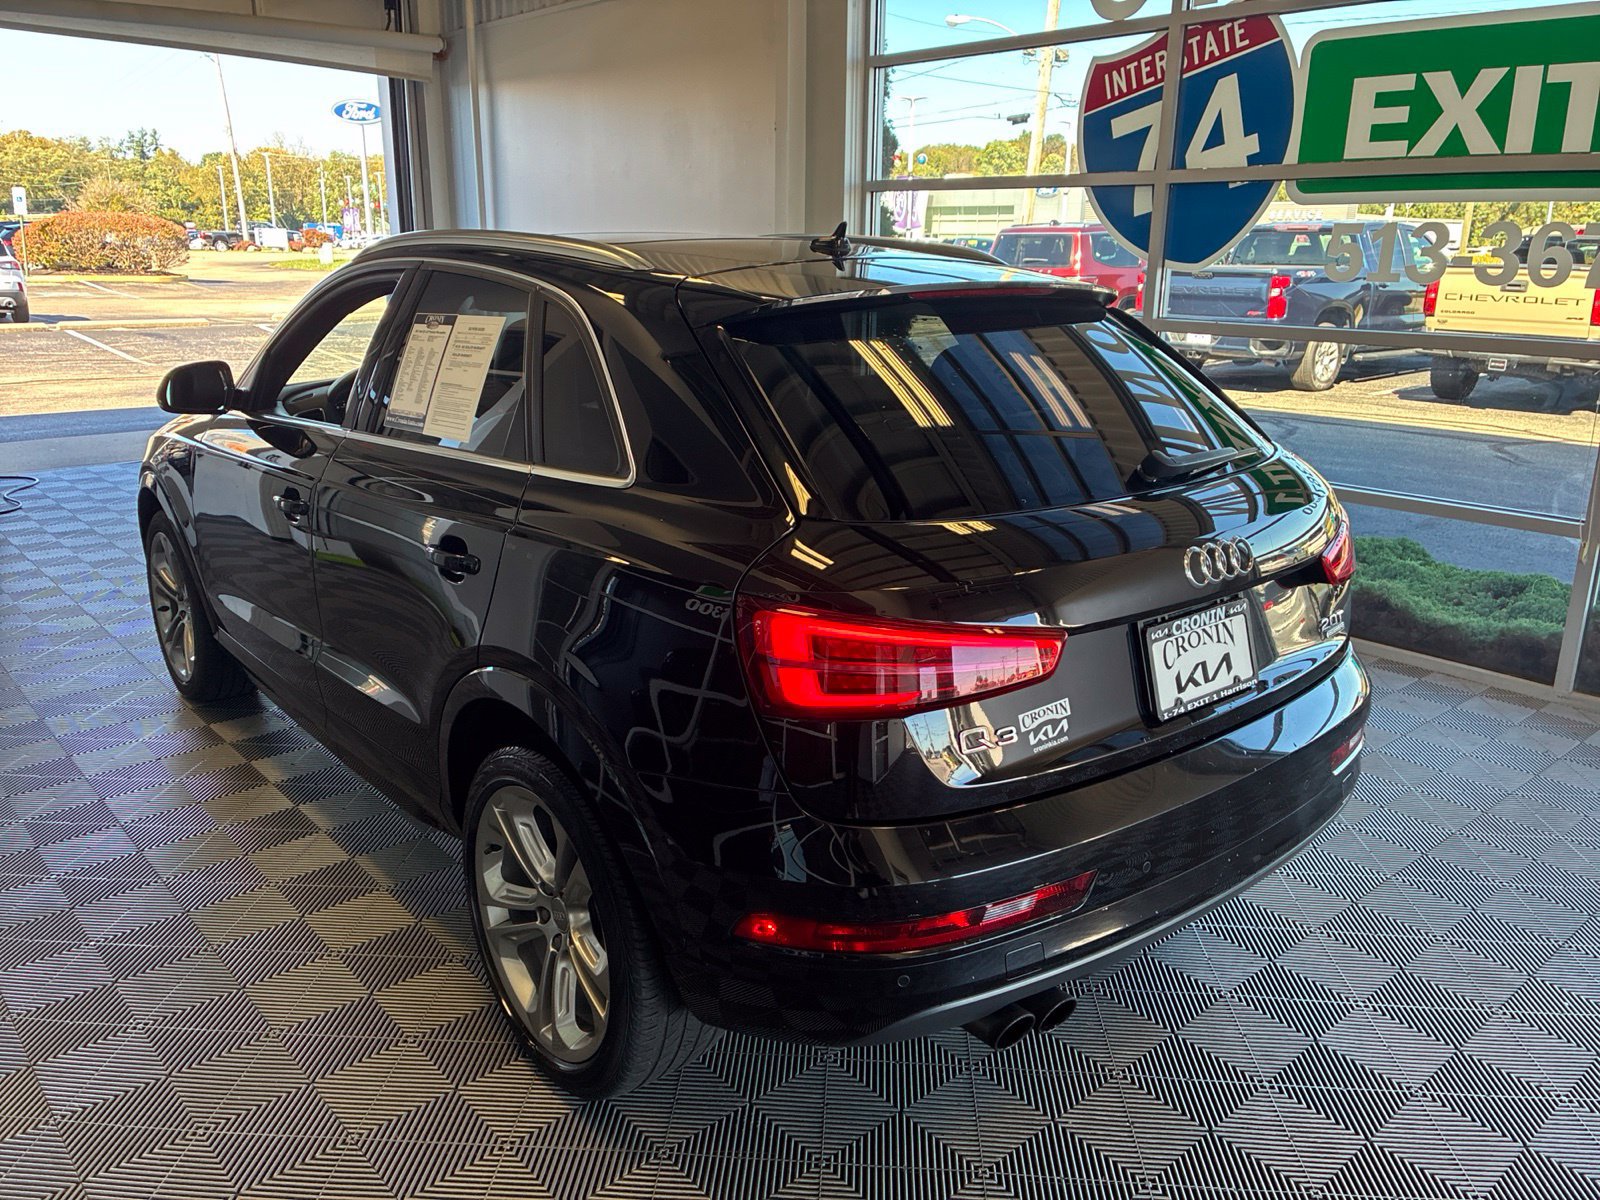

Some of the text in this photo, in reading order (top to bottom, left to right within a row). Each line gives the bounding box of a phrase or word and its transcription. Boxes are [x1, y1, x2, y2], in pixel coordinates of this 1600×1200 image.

[1104, 18, 1250, 100] INTERTATE
[342, 102, 376, 120] Ford
[1343, 61, 1600, 160] EXIT
[1111, 72, 1260, 217] 74
[1444, 292, 1586, 306] CHEVROLET
[1172, 606, 1226, 635] CRONIN
[1163, 619, 1236, 670] CRONIN
[1175, 652, 1233, 694] KIA
[1021, 700, 1069, 729] CRONIN
[1163, 679, 1258, 720] I-74 EXIT 1 Harrison
[959, 725, 1018, 755] Q3
[1028, 718, 1069, 746] KIA
[1033, 735, 1069, 754] croninkia.com
